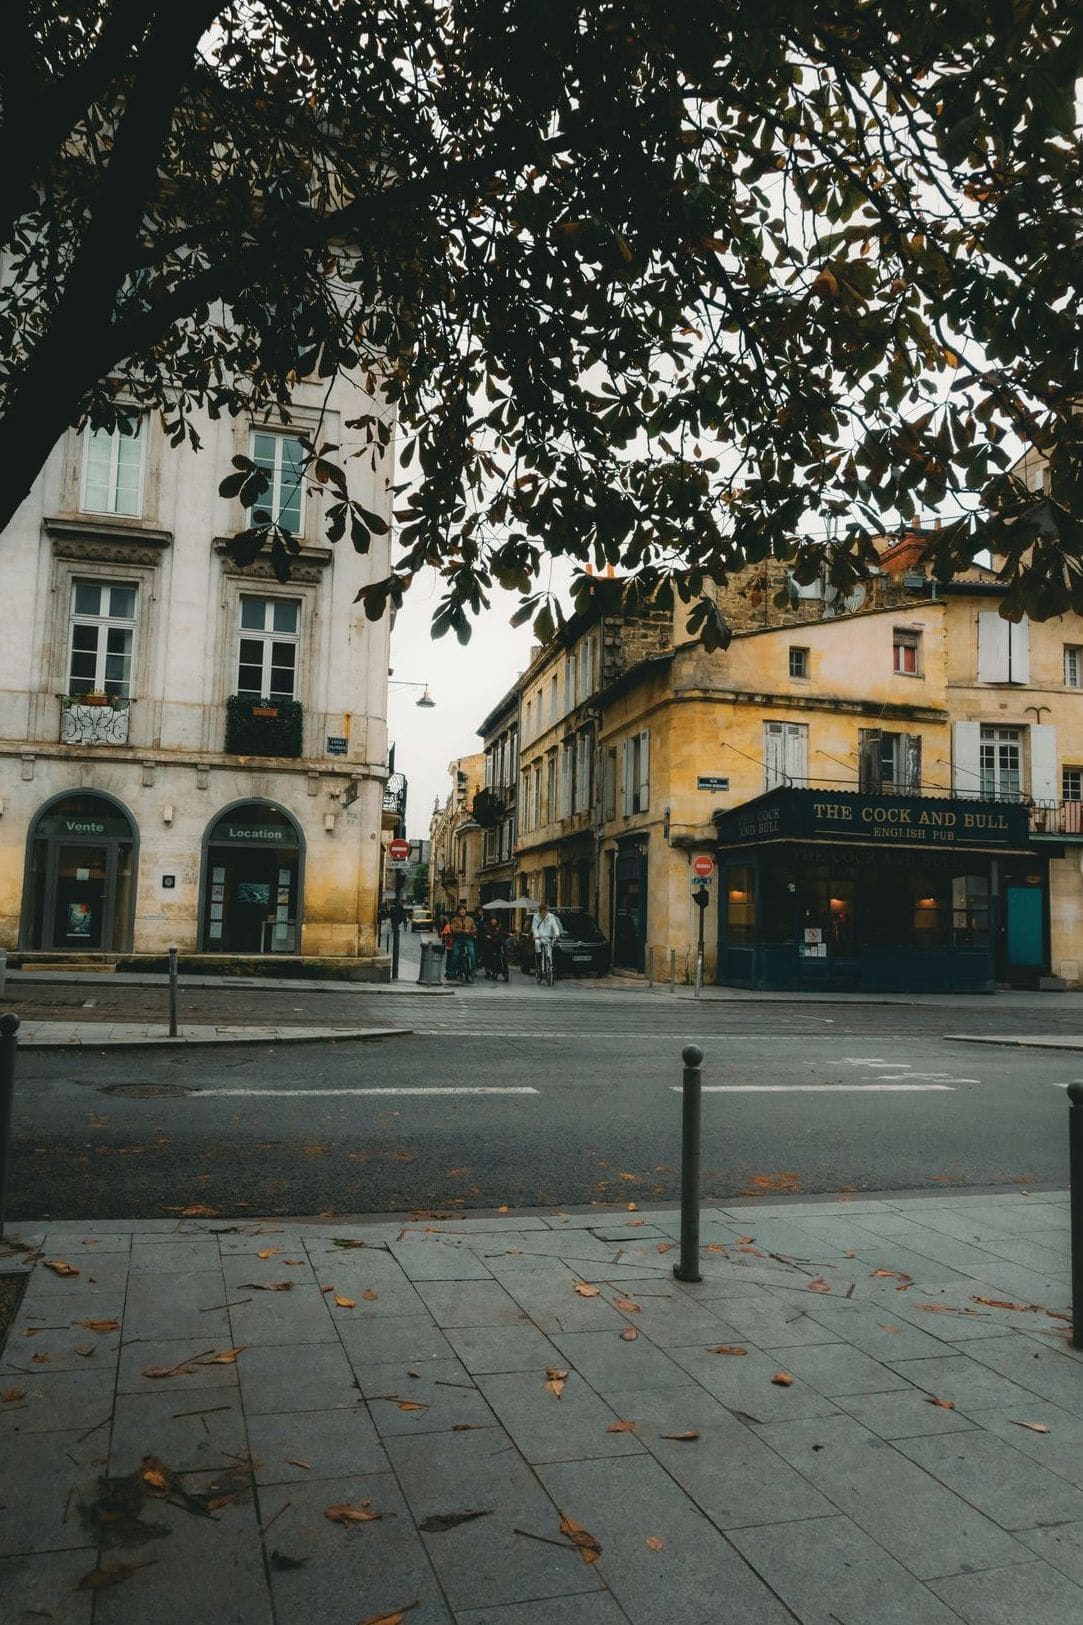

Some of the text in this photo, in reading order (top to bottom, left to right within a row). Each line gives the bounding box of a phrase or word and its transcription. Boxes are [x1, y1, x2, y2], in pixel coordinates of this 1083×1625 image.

[813, 803, 1008, 829] THE COCK AND BULL
[66, 821, 104, 832] Vente
[229, 828, 282, 839] Location
[873, 827, 955, 841] ENGLISH PUB
